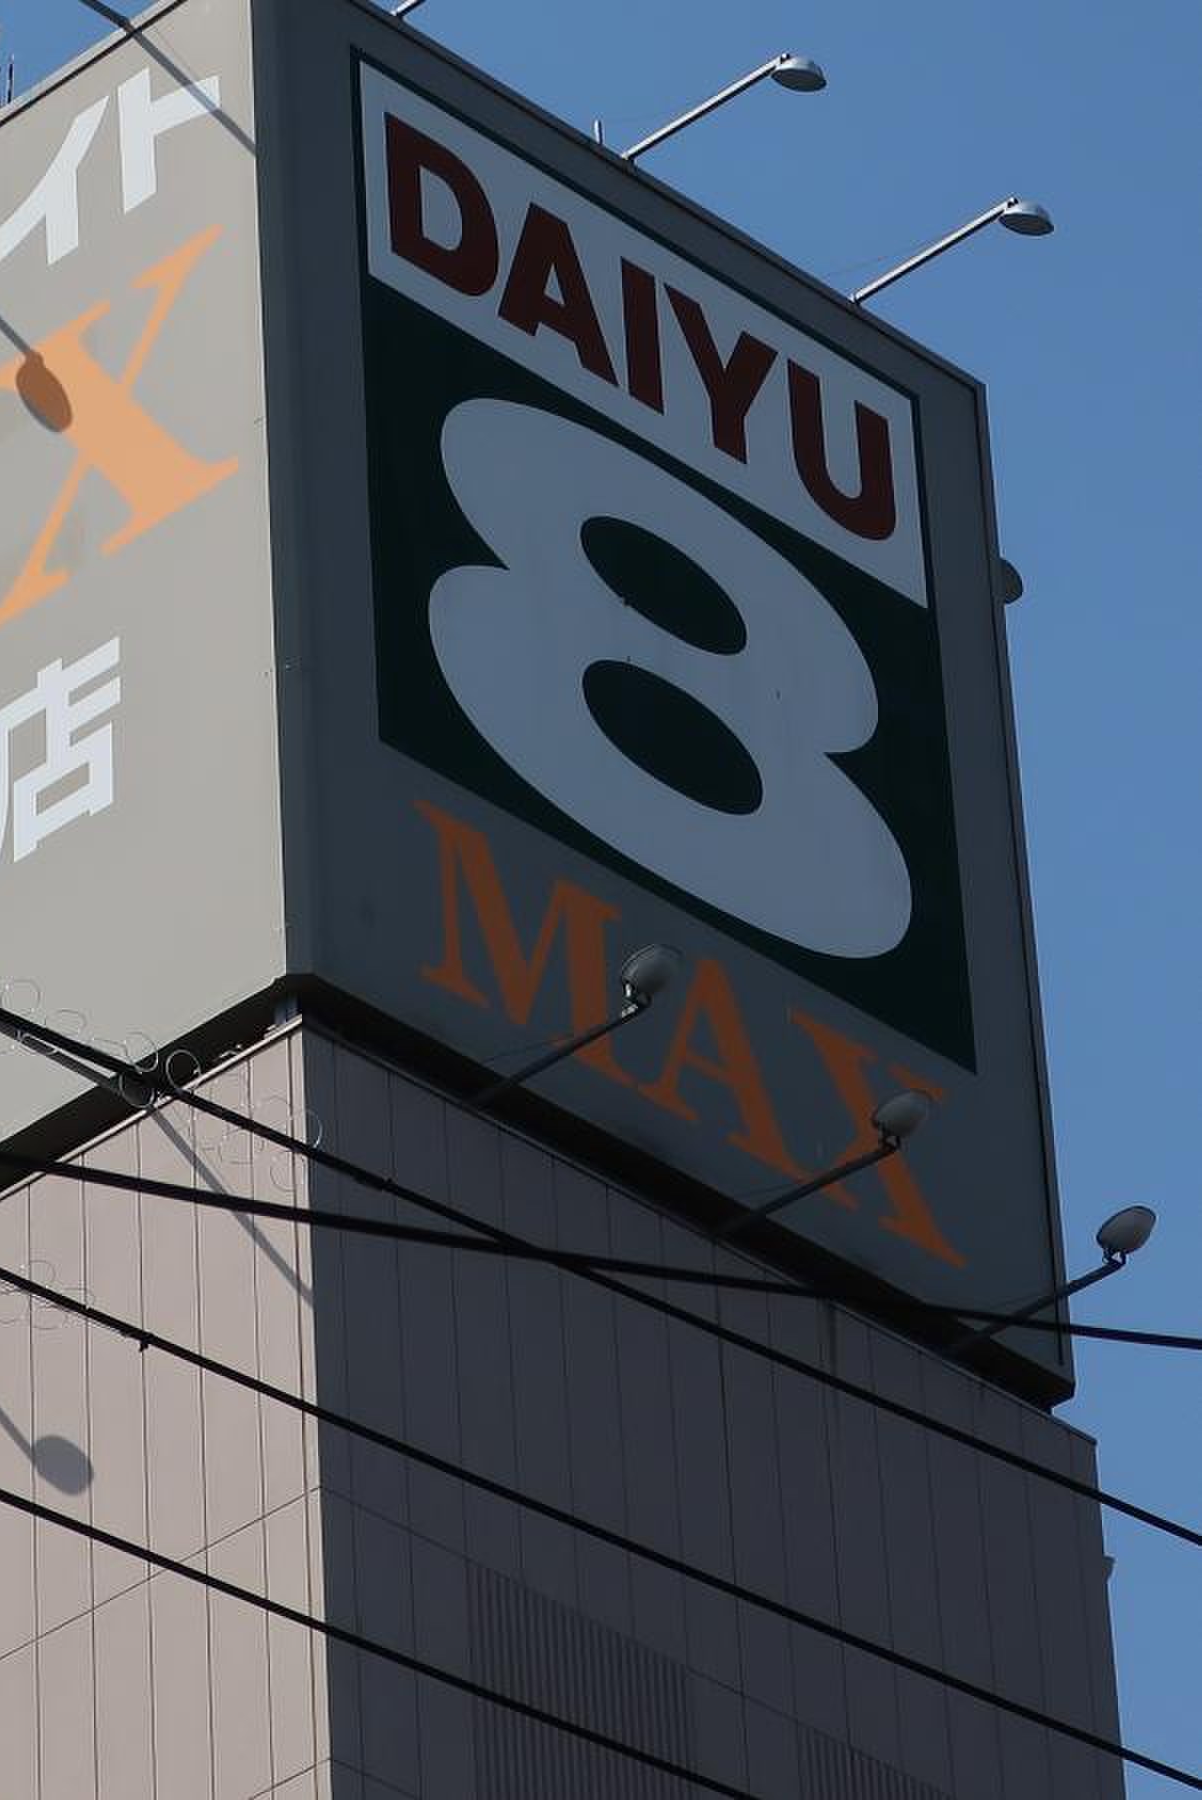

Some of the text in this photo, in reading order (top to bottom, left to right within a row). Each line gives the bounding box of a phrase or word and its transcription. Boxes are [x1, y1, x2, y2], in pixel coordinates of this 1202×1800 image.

[384, 111, 897, 541] DAIYU
[429, 397, 913, 959] 8
[414, 800, 967, 1269] MAX
